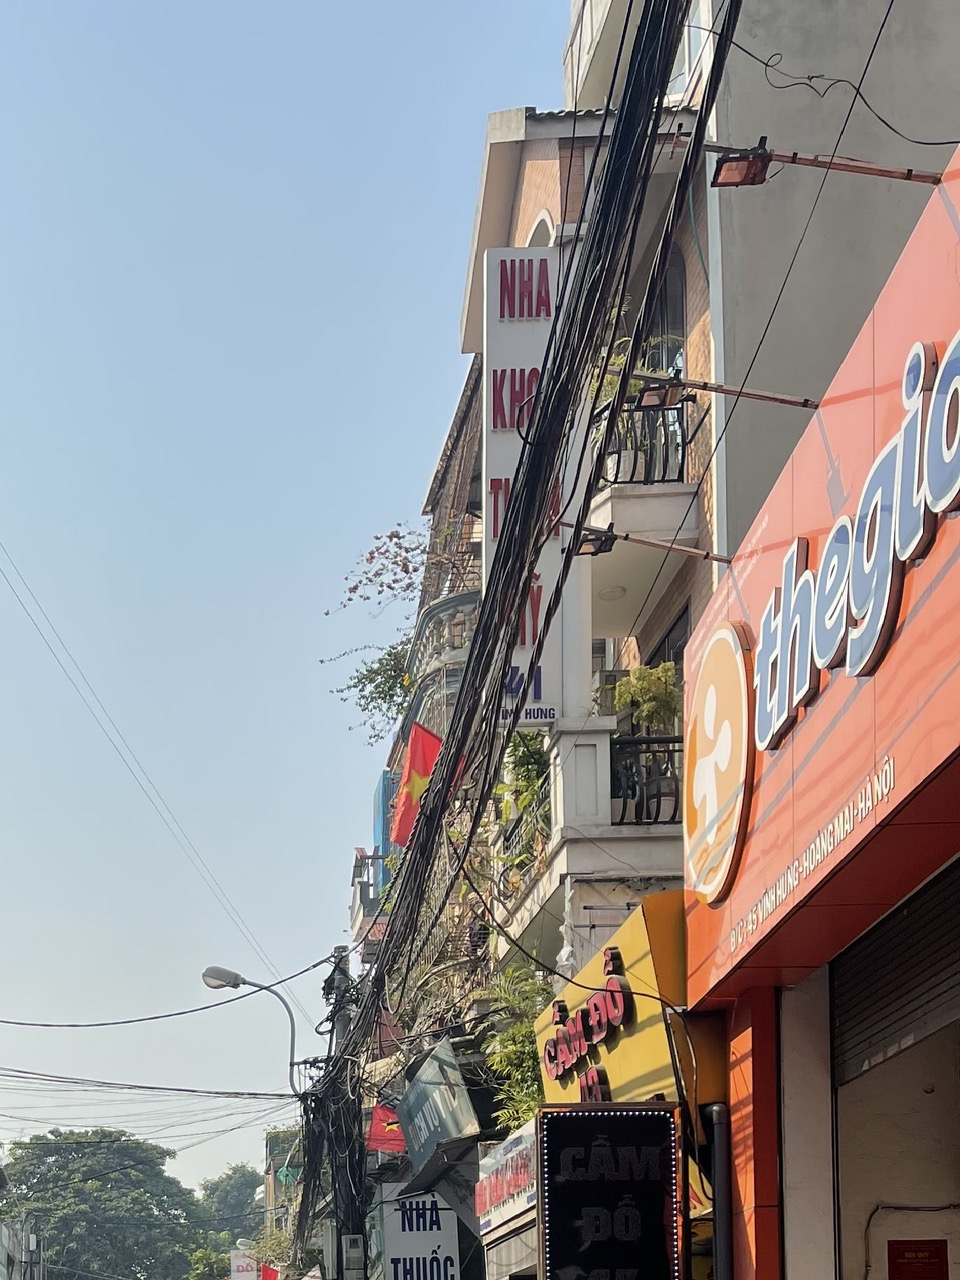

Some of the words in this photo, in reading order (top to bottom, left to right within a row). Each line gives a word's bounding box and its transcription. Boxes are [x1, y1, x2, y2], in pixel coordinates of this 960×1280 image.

[500, 258, 552, 319] NHA
[492, 367, 548, 430] KHO
[834, 804, 855, 847] MAI
[401, 1191, 442, 1232] NHÀ
